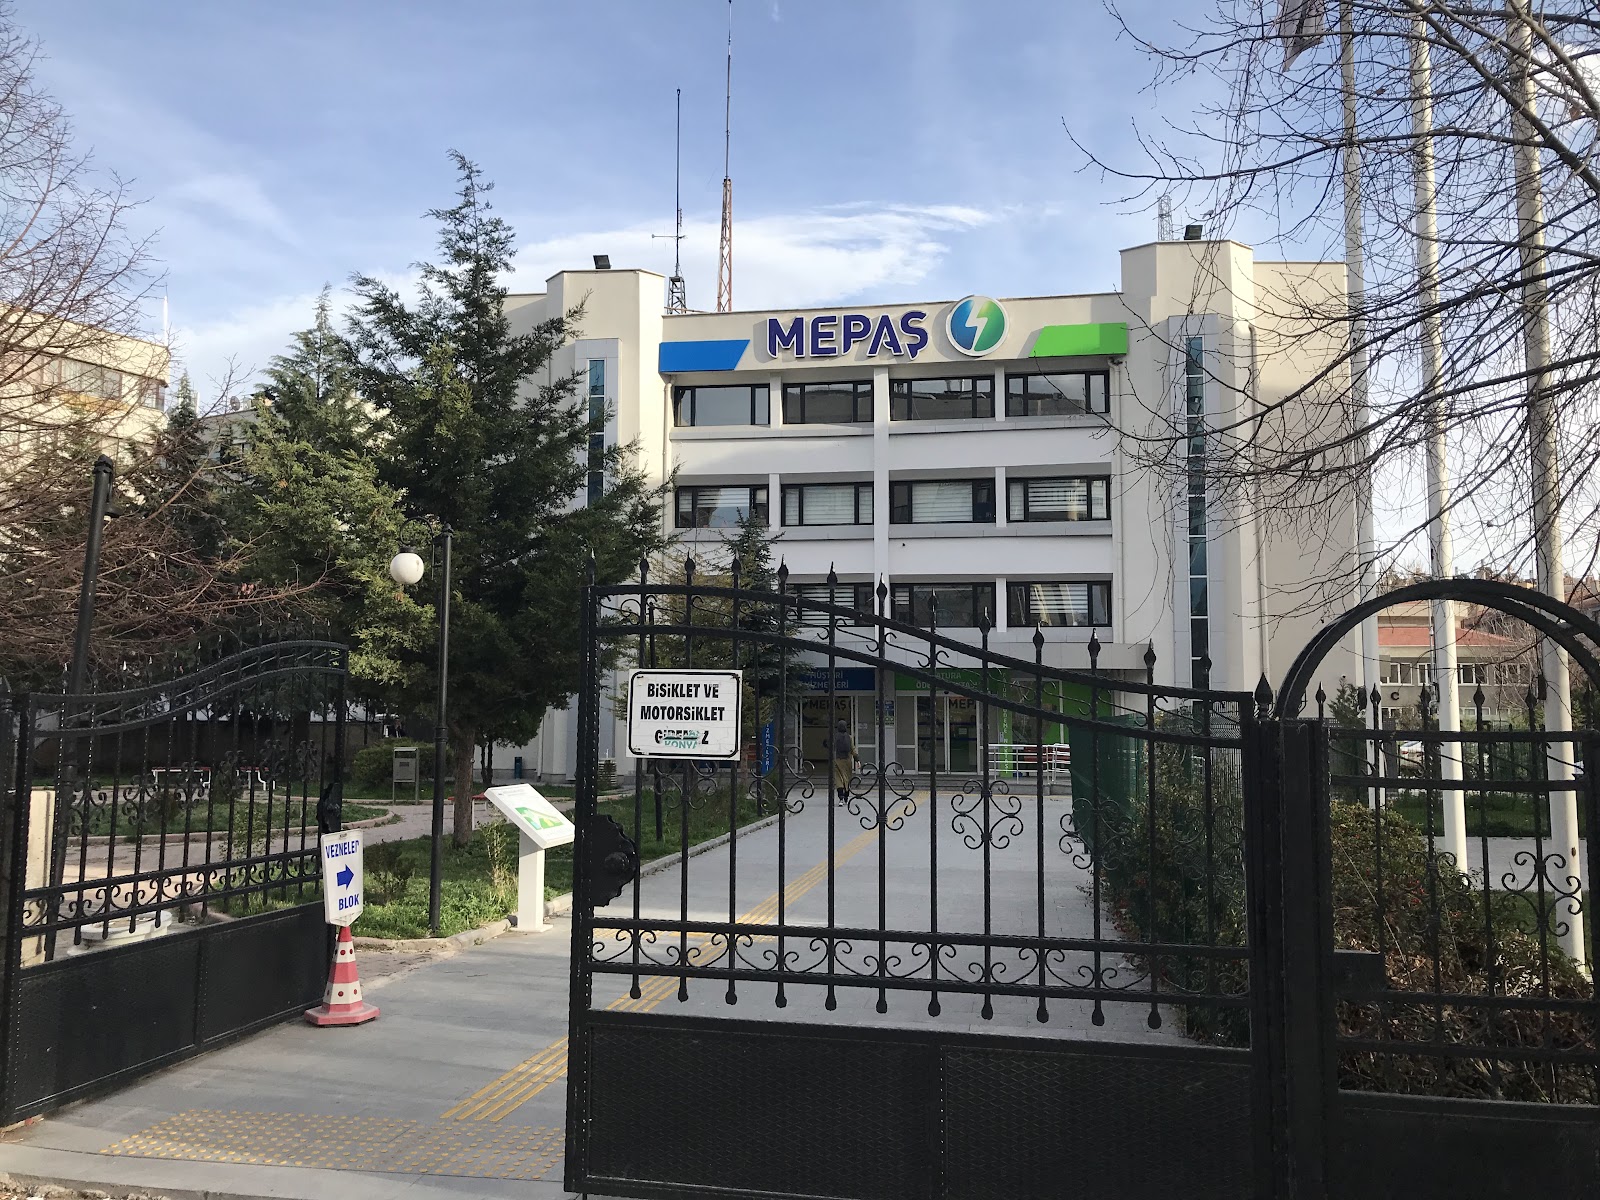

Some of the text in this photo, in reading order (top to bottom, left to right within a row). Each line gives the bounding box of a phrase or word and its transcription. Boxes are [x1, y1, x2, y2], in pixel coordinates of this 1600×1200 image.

[767, 310, 930, 360] MEPAŞ
[935, 672, 962, 680] ATURA
[704, 683, 719, 699] VE
[1391, 692, 1400, 700] C
[339, 894, 359, 910] BLOK
